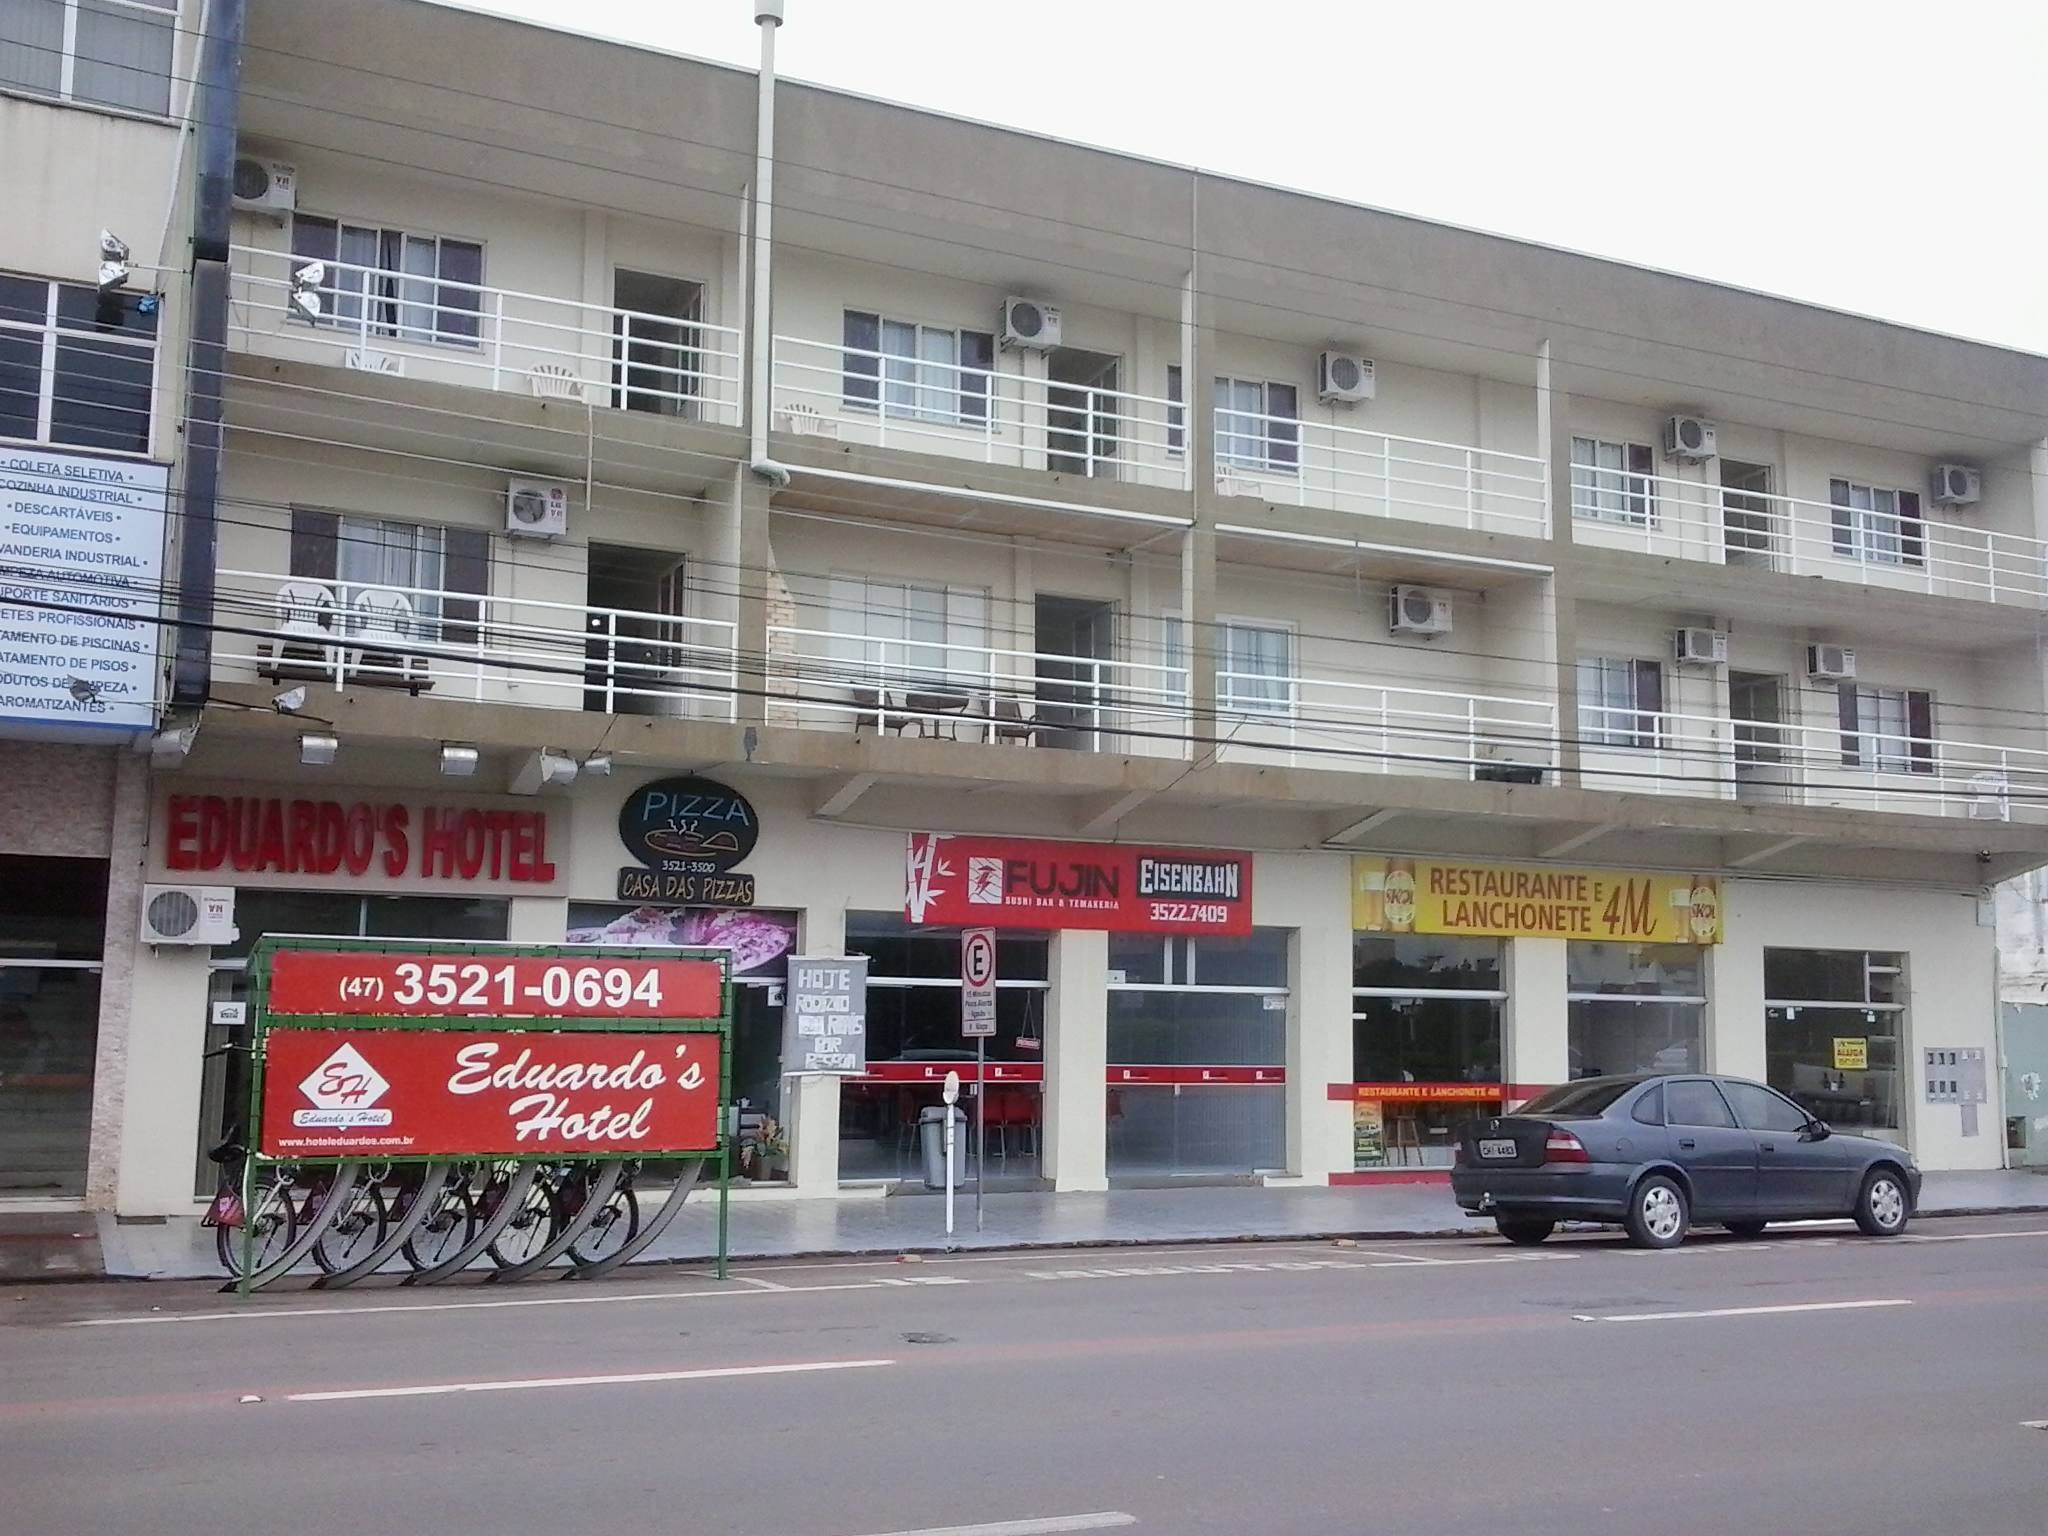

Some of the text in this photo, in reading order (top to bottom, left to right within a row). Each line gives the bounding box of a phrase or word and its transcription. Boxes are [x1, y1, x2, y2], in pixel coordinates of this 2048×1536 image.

[10, 459, 124, 482] COLETA SELETIVA
[58, 486, 133, 504] INDUSTRIAL
[15, 502, 113, 522] DESCARTÁVEIS
[12, 523, 113, 543] EQUIPAMENTOS
[65, 550, 140, 567] INDUSTRIAL
[52, 591, 129, 608] SANITÁRIOS
[38, 612, 136, 630] PROFISSIONAIS
[60, 635, 78, 647] DE
[82, 637, 140, 653] PISCINAS
[70, 657, 87, 669] DE
[91, 659, 129, 672] PISOS
[52, 677, 70, 689] DE
[643, 792, 749, 826] PIZZA
[167, 795, 555, 881] EDUARDO'S HOTEL
[661, 860, 716, 873] 3521-3500
[622, 873, 753, 903] CASA DAS PIZZAS
[1007, 861, 1119, 898] FUJIN
[1140, 858, 1239, 898] EISENBAHN
[1430, 866, 1603, 902] RESTAURANTE E
[1150, 903, 1228, 923] 3522.7409
[1442, 900, 1591, 932] LANCHONETE
[1602, 877, 1658, 936] 4M
[974, 945, 984, 976] E
[339, 963, 663, 1008] (47) 3521-0694
[798, 968, 850, 990] HOJE
[815, 1037, 842, 1053] POR
[448, 1042, 705, 1095] Eduardo's
[318, 1062, 372, 1104] EH
[1358, 1087, 1420, 1097] RESTAURANTE
[1421, 1087, 1428, 1097] E
[1430, 1087, 1486, 1097] LANCHONETE
[300, 1112, 386, 1124] Eduardo's Hotel
[508, 1093, 653, 1142] Hotel
[278, 1136, 414, 1147] www.hoteleduardos.com.br
